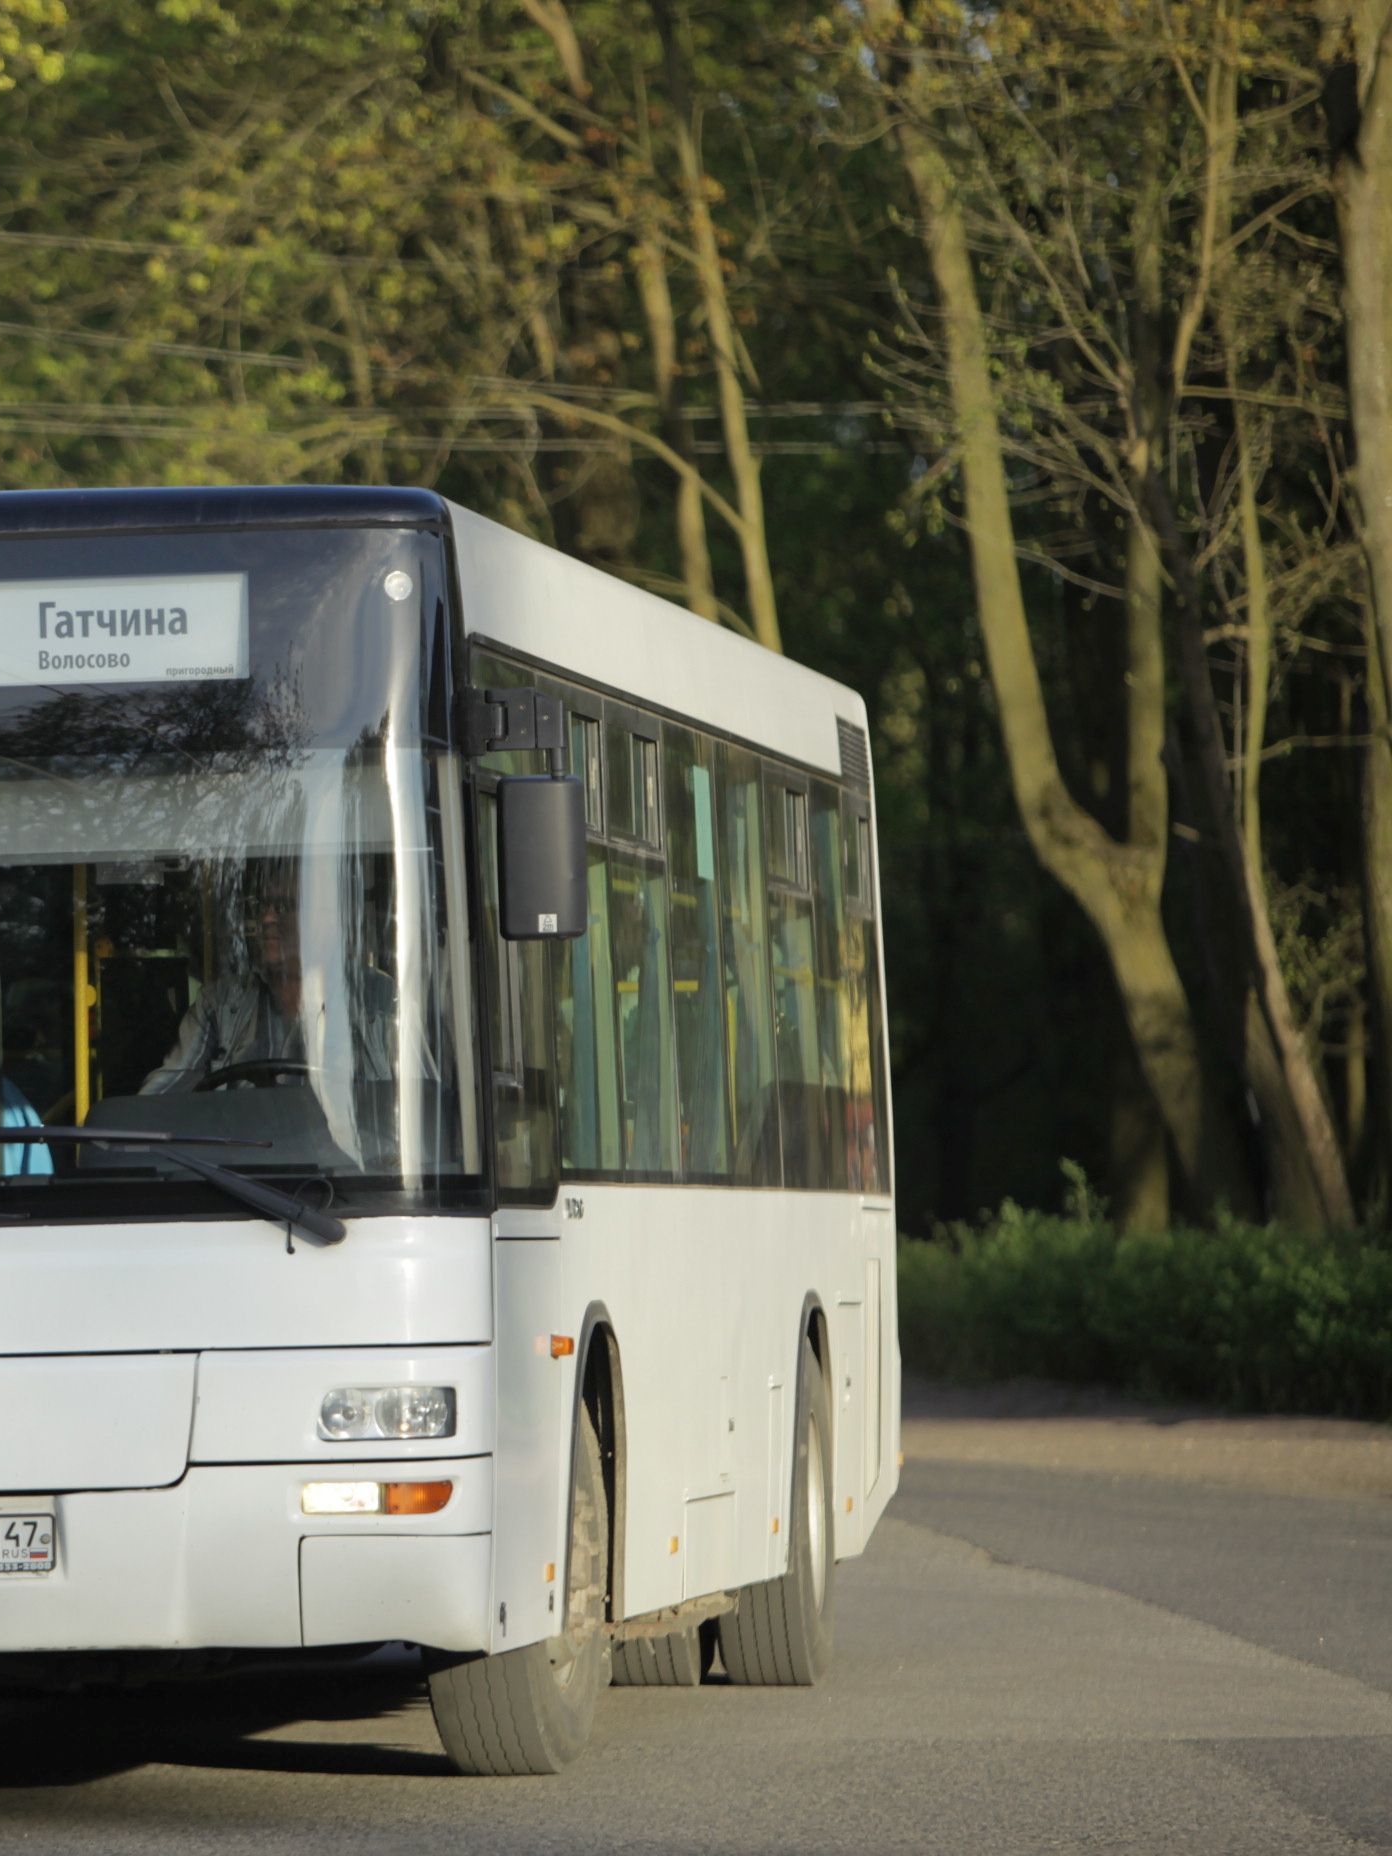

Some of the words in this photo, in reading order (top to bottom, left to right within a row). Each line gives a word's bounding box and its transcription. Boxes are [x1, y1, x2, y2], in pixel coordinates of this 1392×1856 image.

[38, 602, 188, 639] Гатчина
[38, 650, 131, 670] Волосово
[165, 664, 235, 676] пригородный
[5, 1521, 39, 1548] 47
[1, 1549, 29, 1559] RUS
